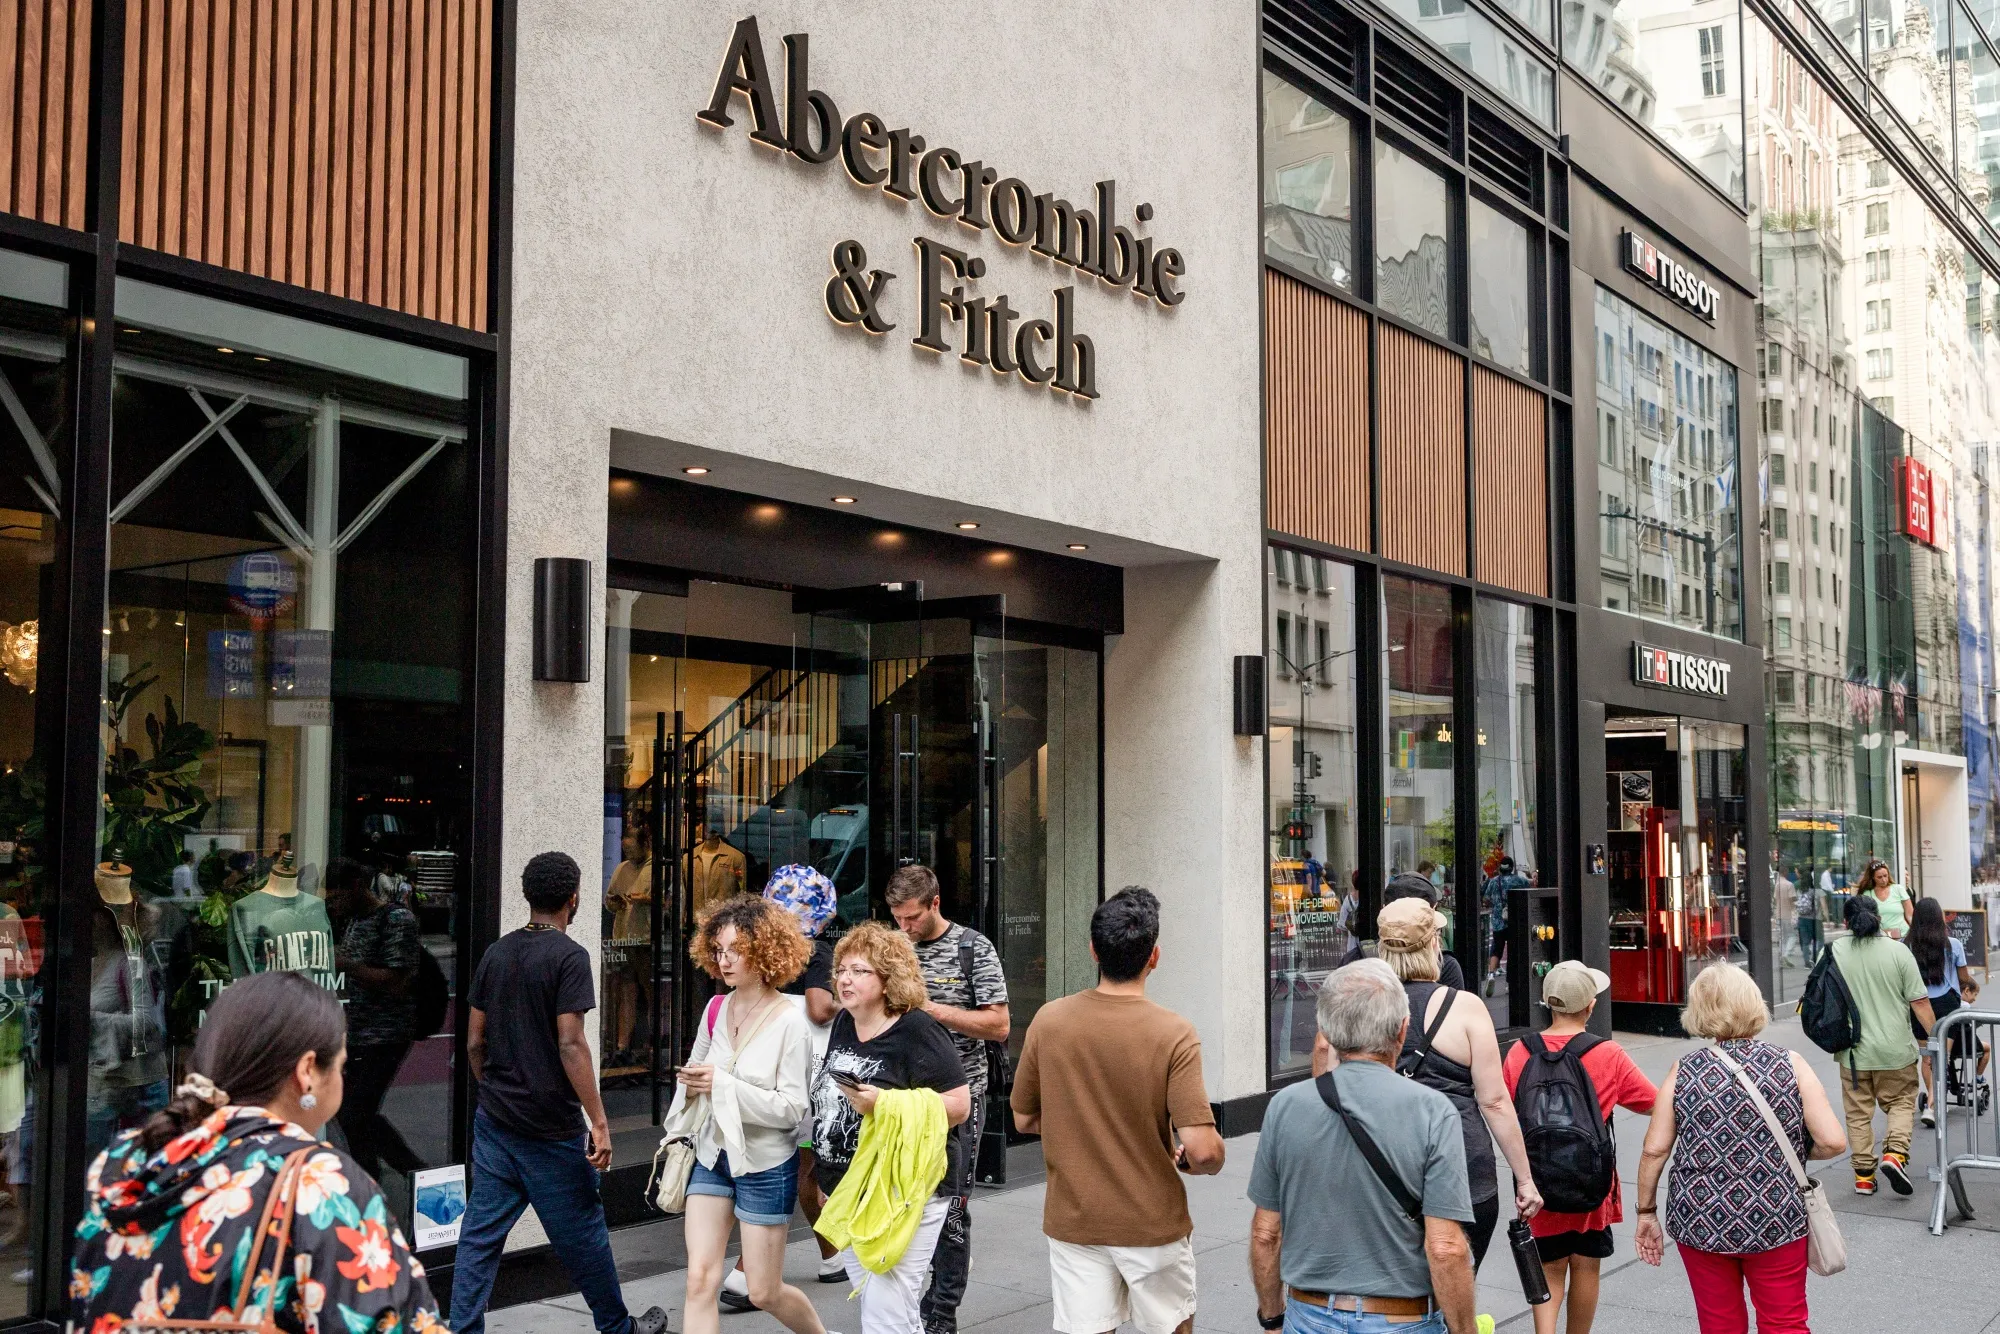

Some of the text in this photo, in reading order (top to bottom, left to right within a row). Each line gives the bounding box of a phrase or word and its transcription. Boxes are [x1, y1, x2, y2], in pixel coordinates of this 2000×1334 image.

[695, 15, 1185, 307] Abercrombie
[1657, 249, 1720, 320] TISSOT
[825, 236, 1100, 400] & Fitch
[1667, 651, 1731, 695] TISSOT
[1295, 897, 1337, 909] THE DENIM
[602, 935, 643, 948] crombie
[1015, 924, 1031, 935] Fitch
[264, 931, 308, 972] GAME
[428, 1228, 456, 1239] LifeWear
[948, 1196, 964, 1244] EASY
